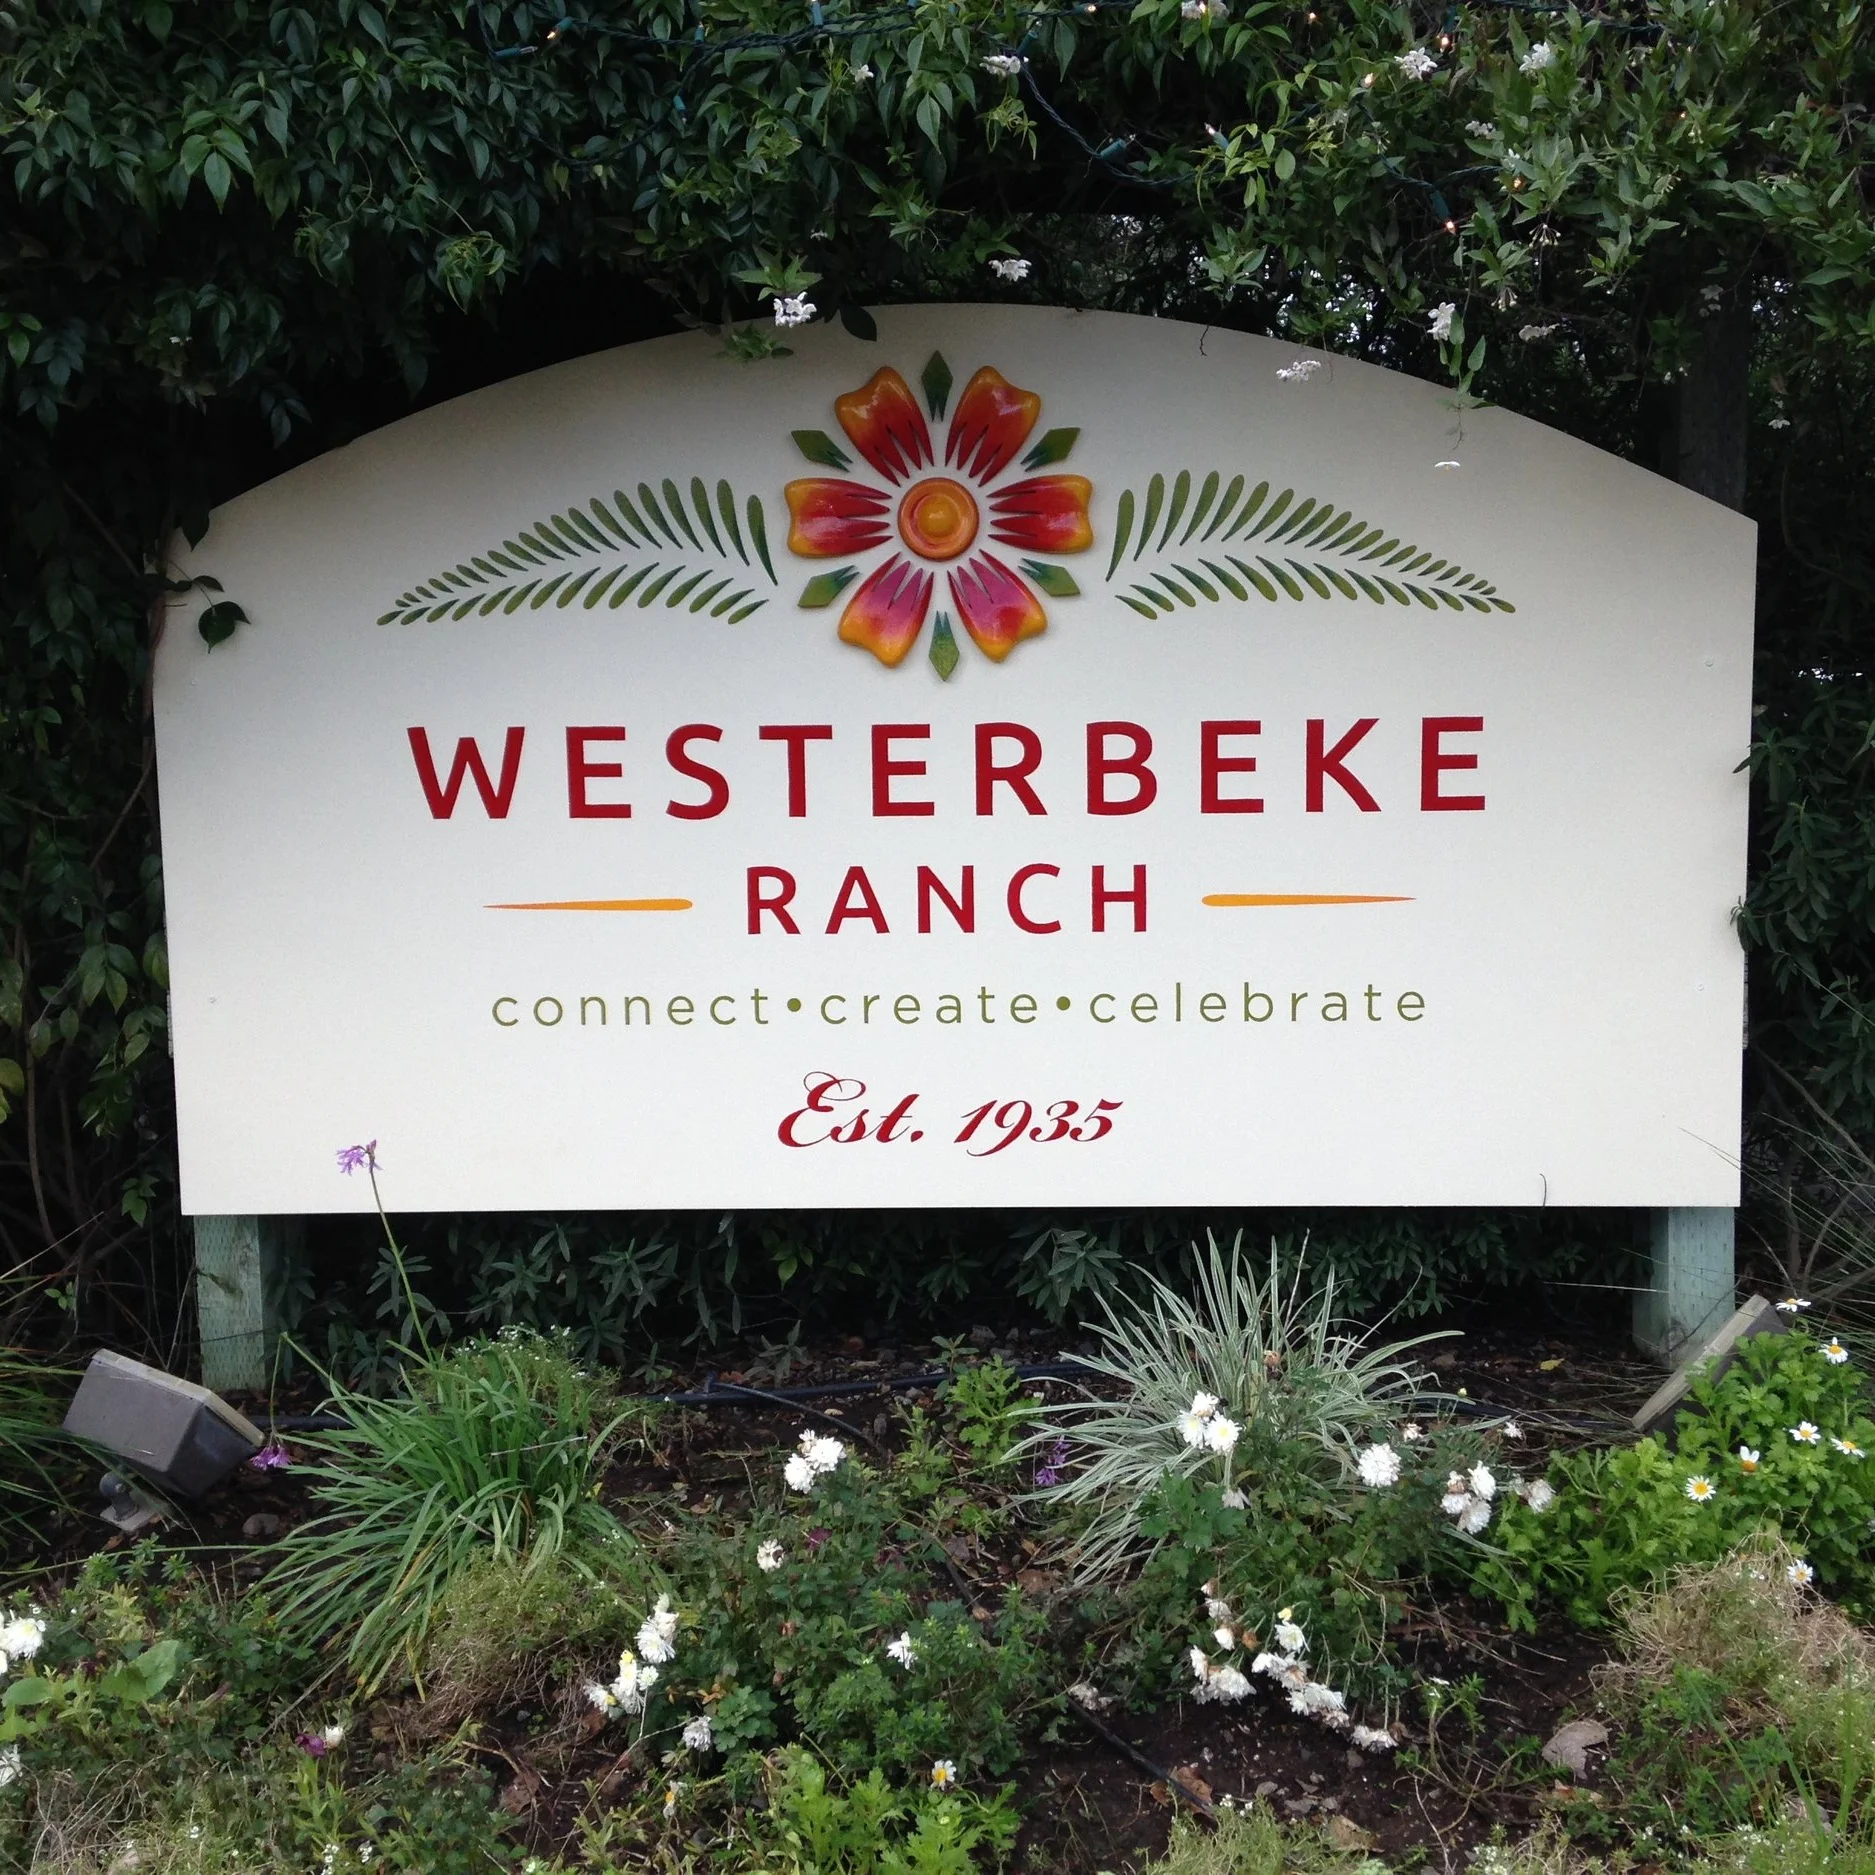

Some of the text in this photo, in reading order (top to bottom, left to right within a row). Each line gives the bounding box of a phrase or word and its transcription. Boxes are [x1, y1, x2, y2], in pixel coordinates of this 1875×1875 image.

[407, 717, 1486, 821] WESTERBEKE
[746, 862, 1148, 935] RANCH
[491, 981, 1427, 1027] connect create celebrate
[777, 1071, 1124, 1157] Est. 1935
